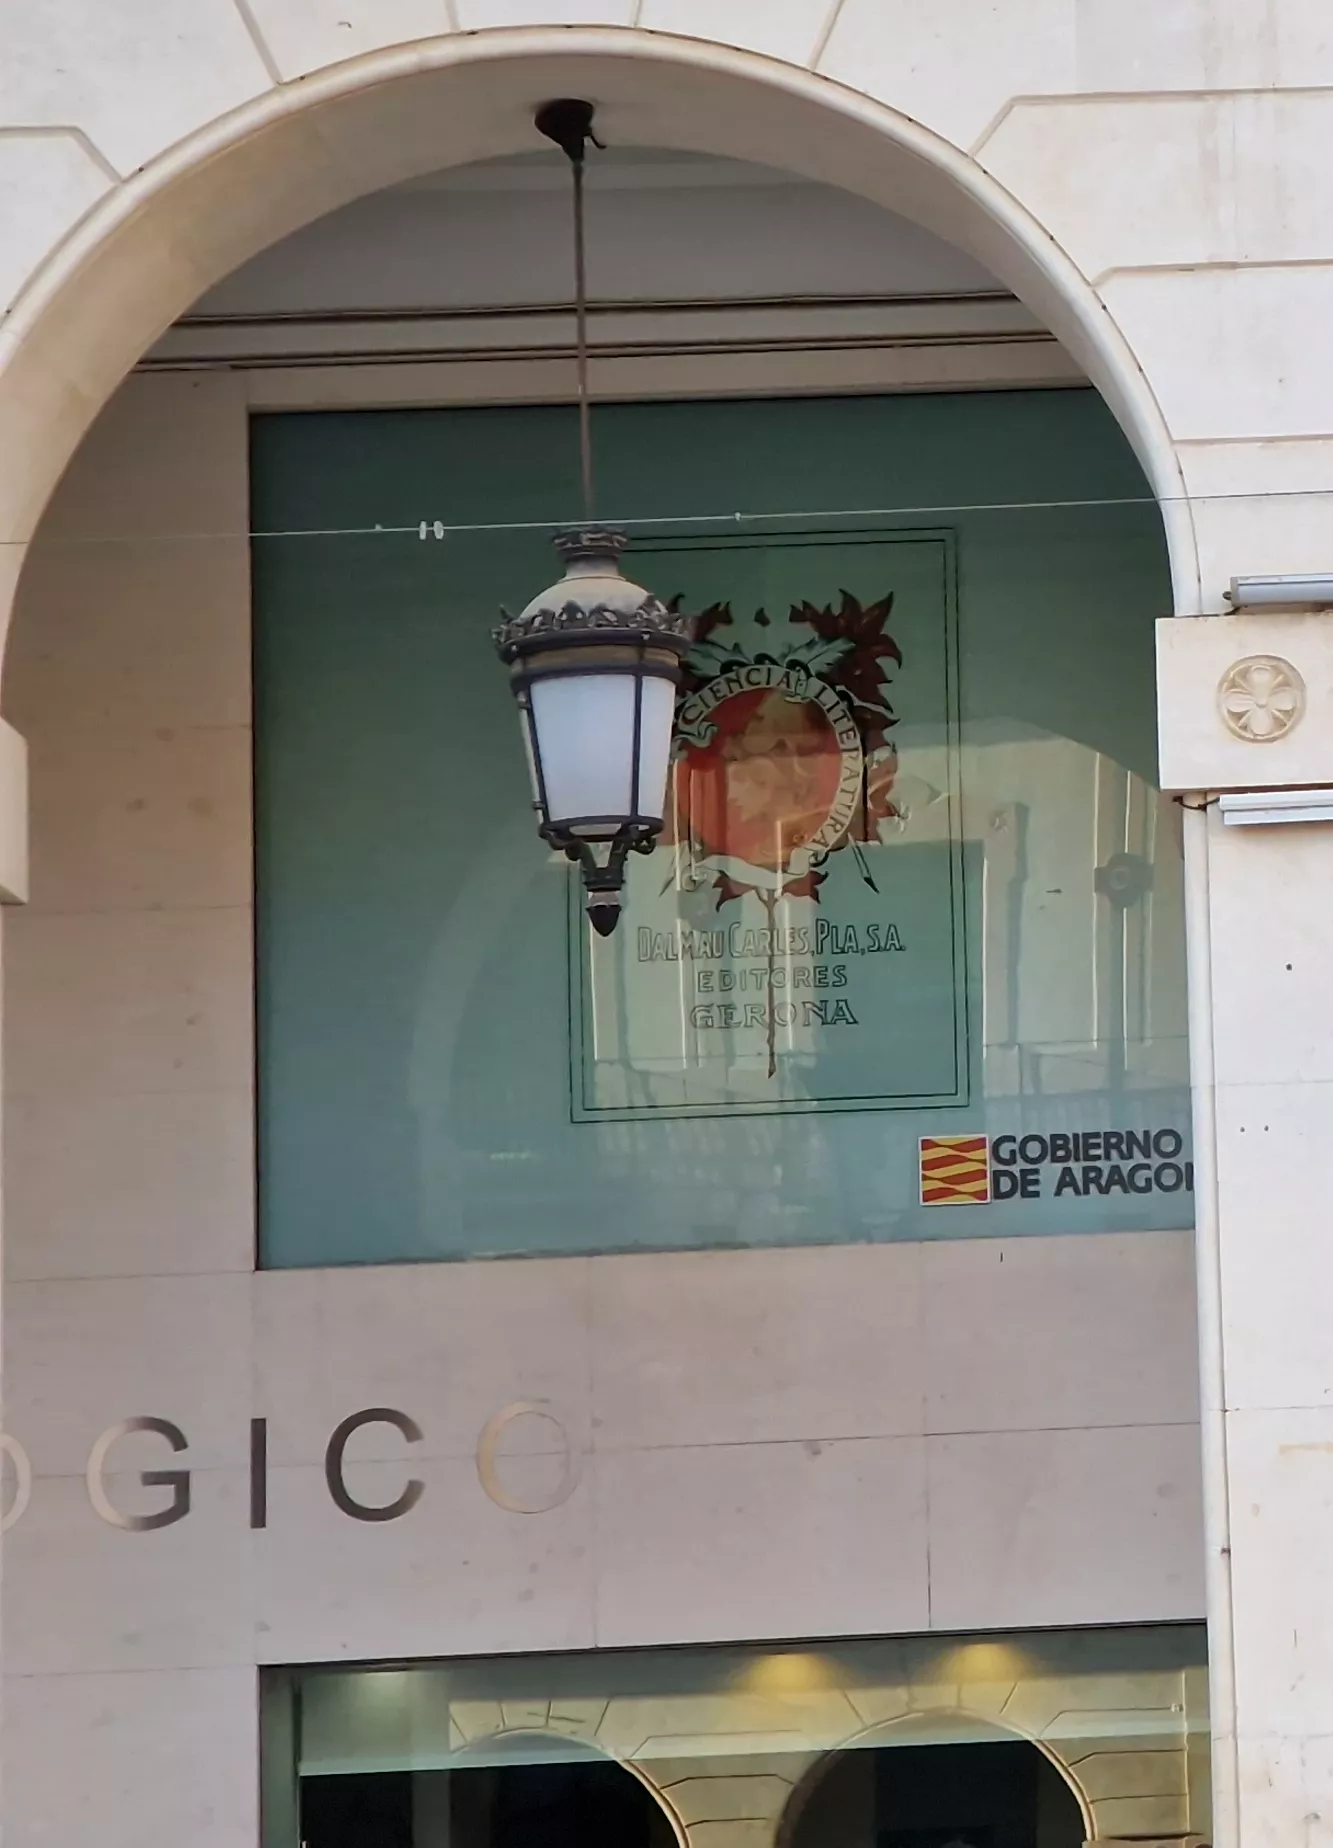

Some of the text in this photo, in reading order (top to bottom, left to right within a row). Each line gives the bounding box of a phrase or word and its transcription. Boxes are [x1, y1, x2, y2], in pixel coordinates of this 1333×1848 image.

[697, 965, 848, 993] EDITORES
[690, 999, 859, 1030] GERONA
[992, 1128, 1182, 1166] GOBIERNO
[993, 1168, 1040, 1200] DE
